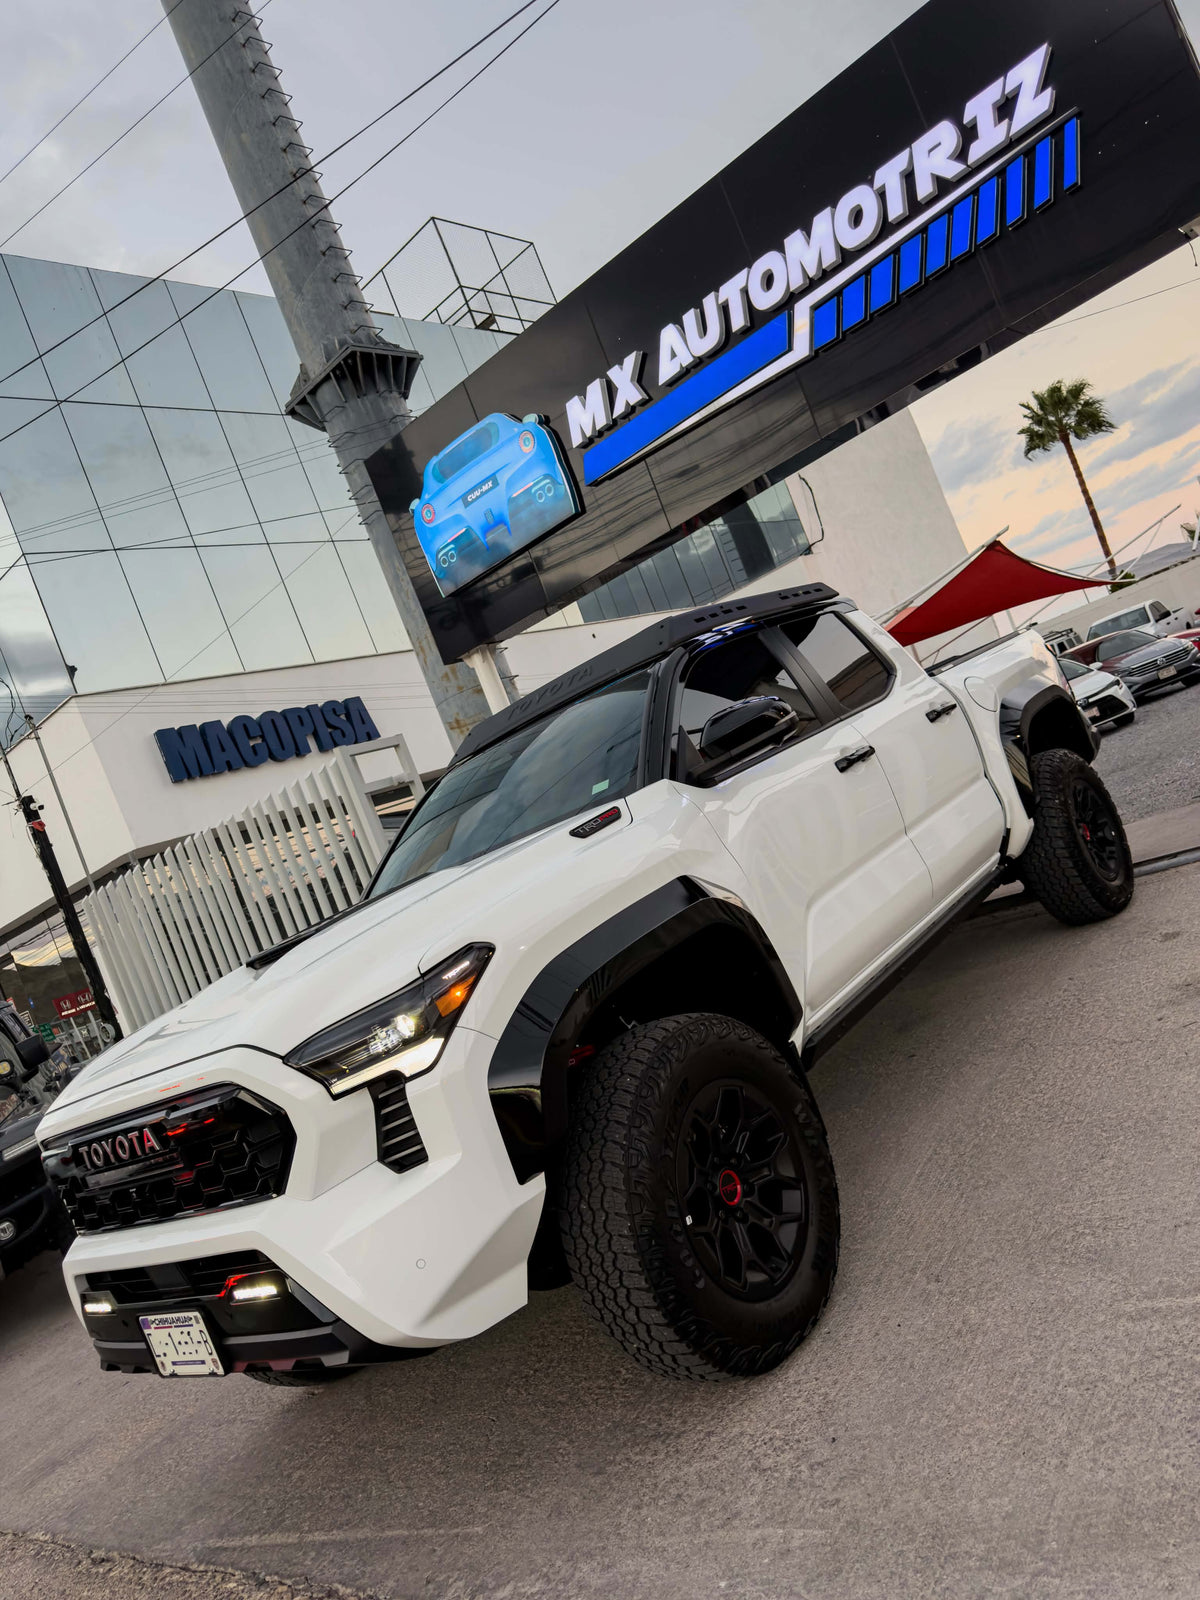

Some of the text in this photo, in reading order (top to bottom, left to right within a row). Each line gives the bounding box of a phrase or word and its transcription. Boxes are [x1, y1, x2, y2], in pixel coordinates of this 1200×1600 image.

[565, 42, 1056, 449] MX AUTOMOTRIZ
[467, 480, 493, 502] CUU-MX
[507, 664, 593, 721] TOYOTA
[153, 696, 381, 784] MACOPISA
[78, 1127, 161, 1171] TOYOTA
[153, 1315, 190, 1326] CHIHUAHUA
